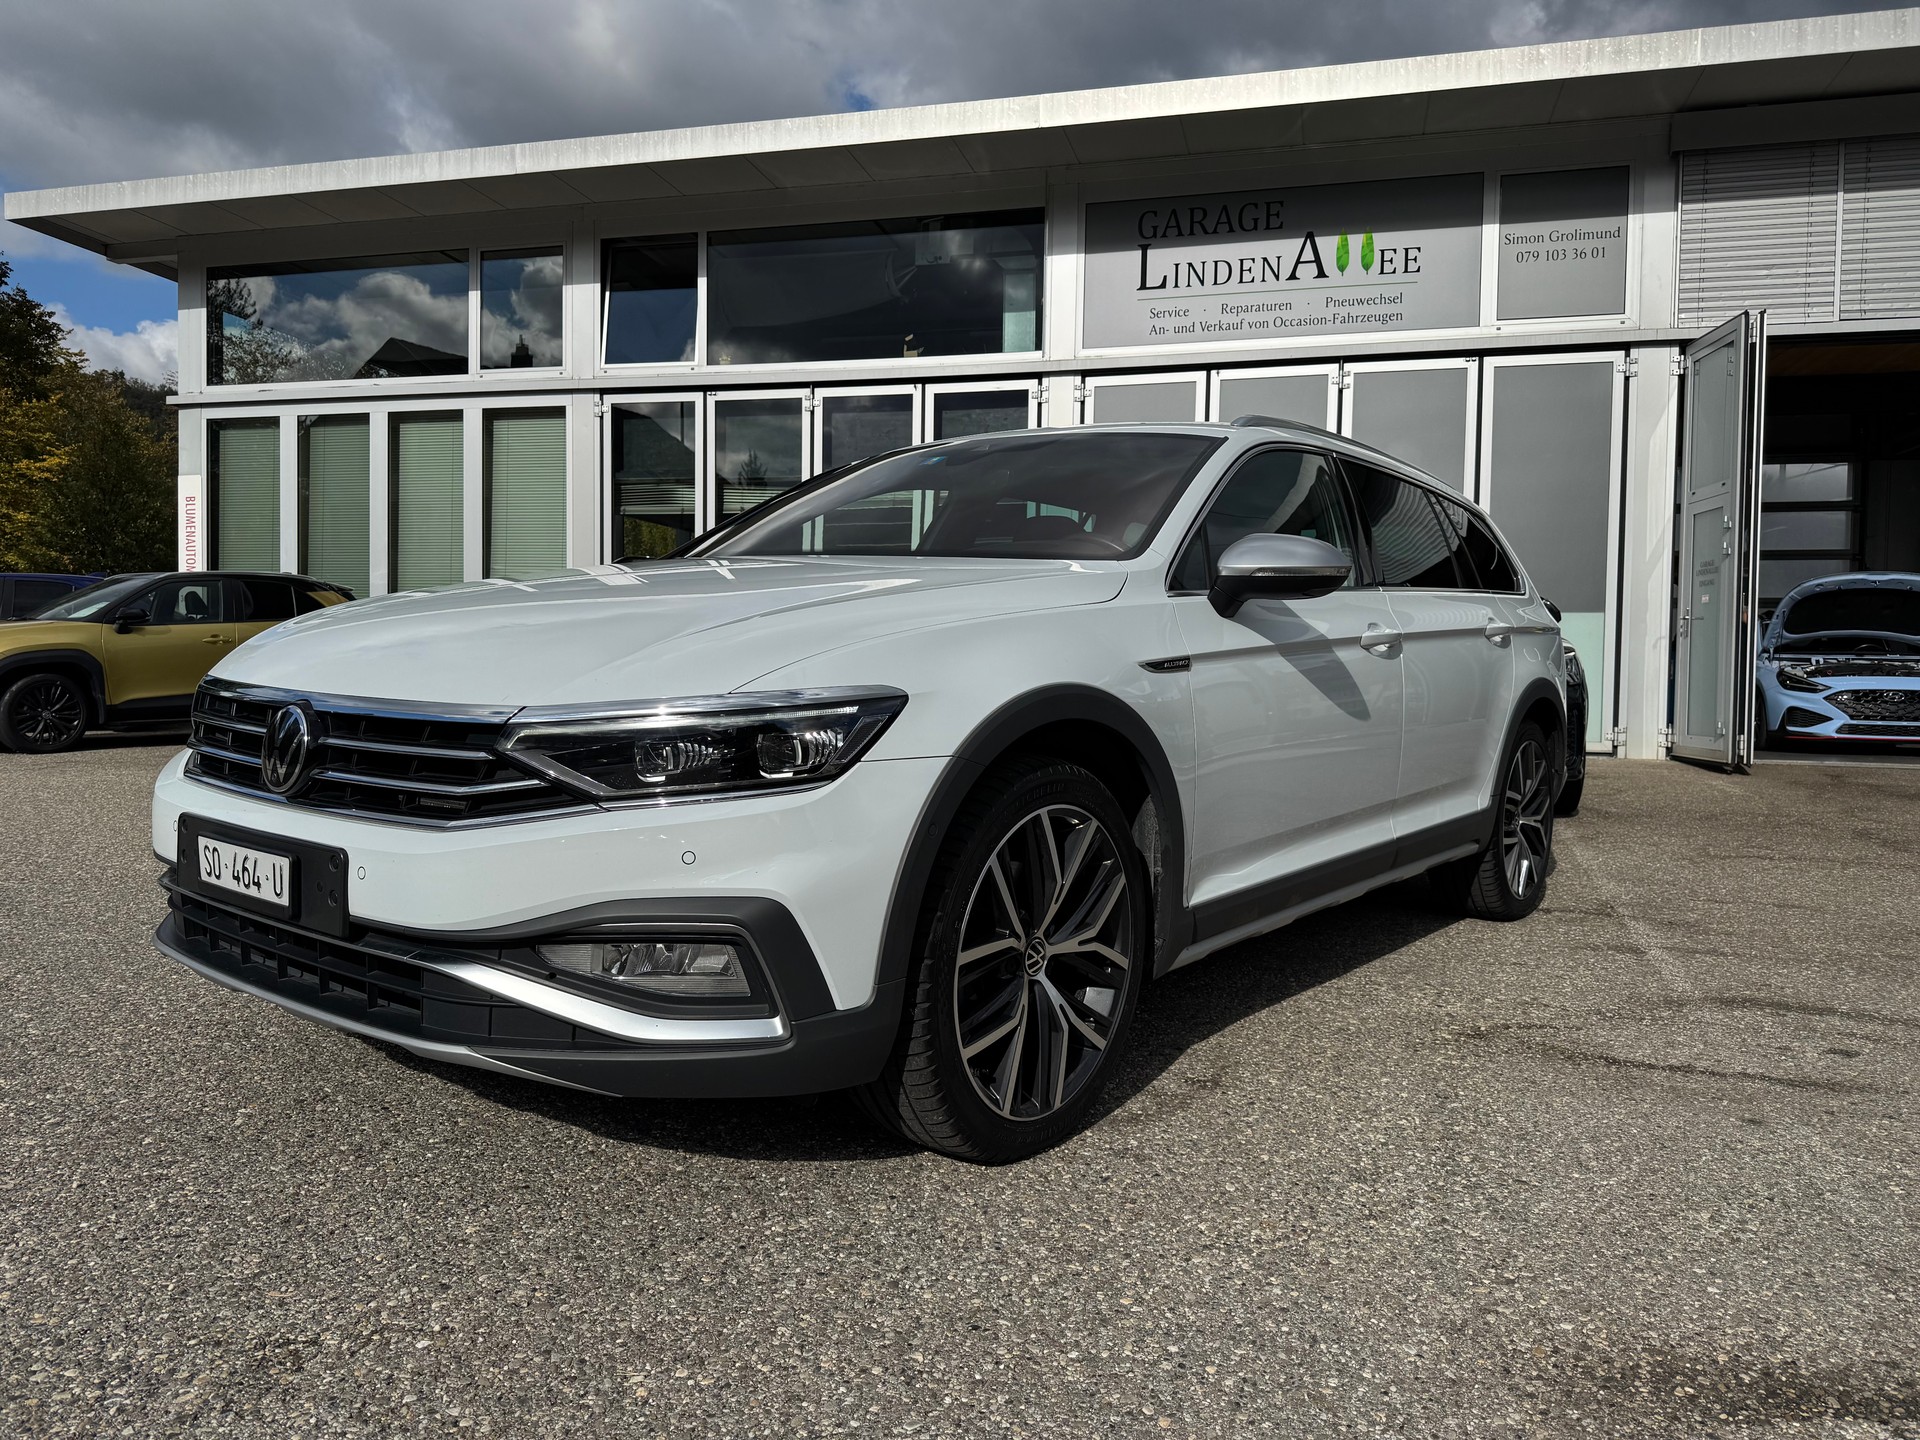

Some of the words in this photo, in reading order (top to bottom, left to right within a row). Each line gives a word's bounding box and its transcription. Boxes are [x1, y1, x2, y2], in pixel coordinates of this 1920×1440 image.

[1137, 200, 1285, 240] GARAGE
[1504, 232, 1545, 246] Simon
[1548, 226, 1621, 243] Grolimund
[1515, 250, 1540, 263] 079
[1545, 248, 1567, 261] 103
[1571, 247, 1587, 260] 36
[1591, 246, 1606, 259] 01
[1149, 306, 1190, 319] Service
[1220, 301, 1292, 317] Reparaturen
[1325, 292, 1403, 308] Pneuwechsel
[1149, 324, 1170, 336] An-
[1173, 321, 1195, 334] und
[1199, 318, 1246, 333] Verkauf
[1247, 320, 1269, 330] von
[1272, 312, 1403, 328] Occasion-Fahrzeugen
